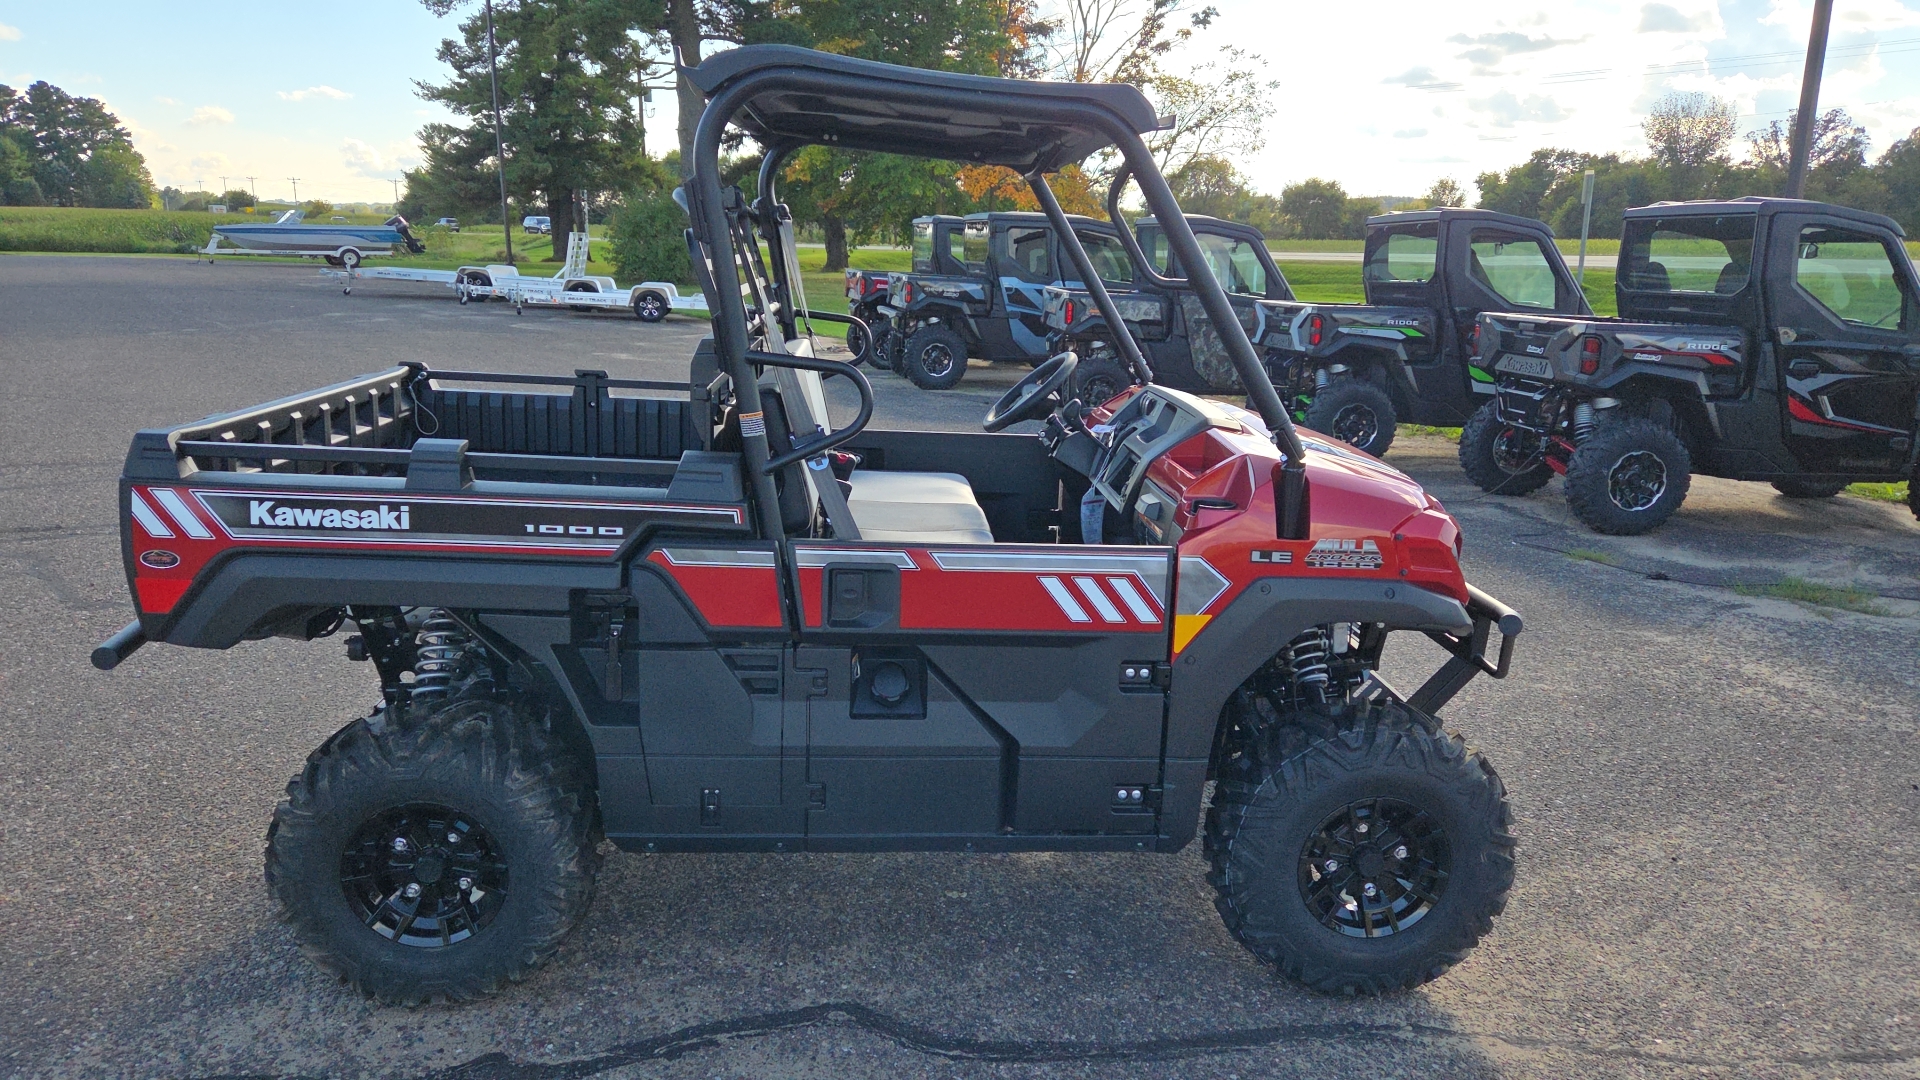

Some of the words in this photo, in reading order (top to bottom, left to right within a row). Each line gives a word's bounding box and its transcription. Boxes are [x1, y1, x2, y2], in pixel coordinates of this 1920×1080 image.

[1687, 342, 1728, 351] RIDGE
[1503, 355, 1549, 376] Kawasaki
[250, 500, 410, 530] Kawasaki
[525, 524, 623, 535] 1000
[1251, 550, 1292, 562] LE
